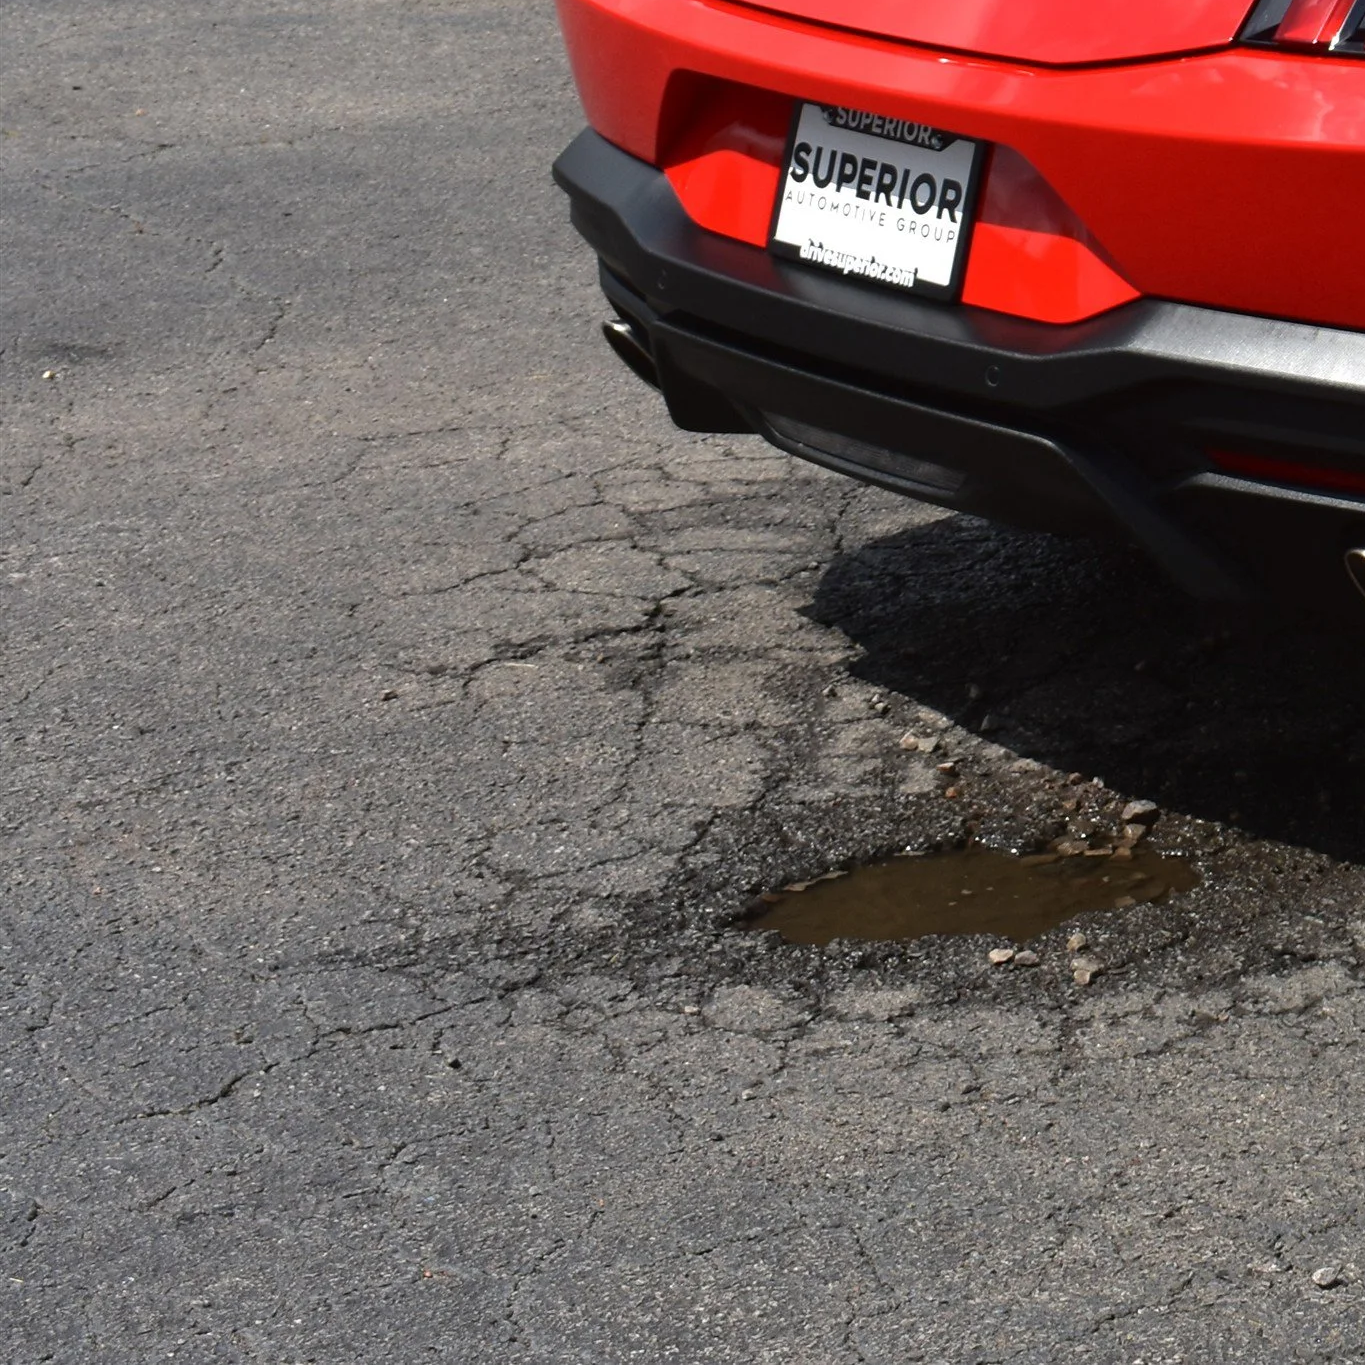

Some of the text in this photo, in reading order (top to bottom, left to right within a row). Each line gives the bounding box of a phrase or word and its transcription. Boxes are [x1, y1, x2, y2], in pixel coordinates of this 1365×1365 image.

[835, 106, 933, 146] SUPERIOR
[790, 141, 963, 223] SUPERIOR
[785, 189, 956, 244] AUTOMOTIVE GROUP
[800, 238, 915, 288] drivesuperior.com
